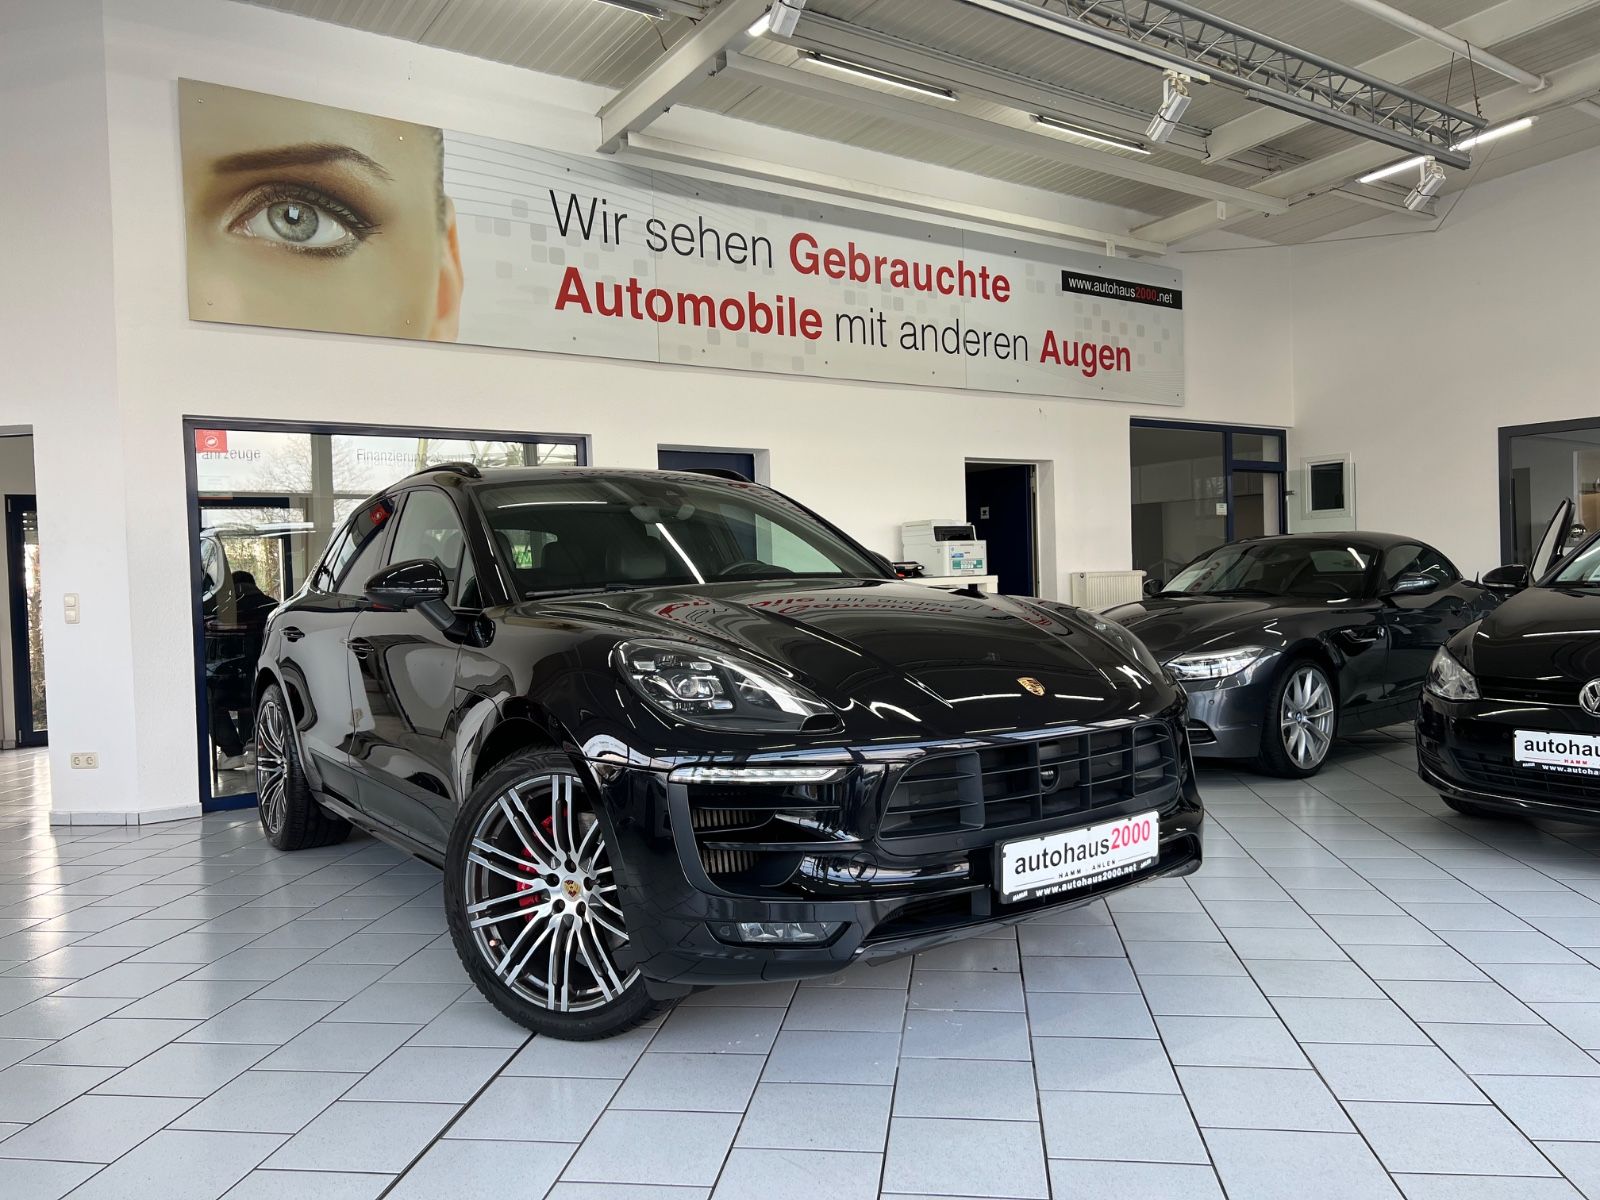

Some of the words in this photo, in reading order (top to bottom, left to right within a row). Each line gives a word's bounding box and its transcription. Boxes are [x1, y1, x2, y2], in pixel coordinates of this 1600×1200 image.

[549, 189, 628, 245] Wir
[645, 215, 772, 268] sehen
[789, 231, 1011, 303] Gebrauchte
[1068, 277, 1173, 304] www.autohaus2000.net
[554, 266, 823, 340] Automobile
[835, 307, 888, 348] mit
[899, 318, 1029, 362] anderen
[1039, 329, 1132, 378] Augen
[1541, 764, 1600, 776] www.autoha
[1014, 819, 1150, 875] autohaus2000
[1035, 863, 1137, 897] www.autohaus2000.net
[1058, 868, 1082, 879] HAMM
